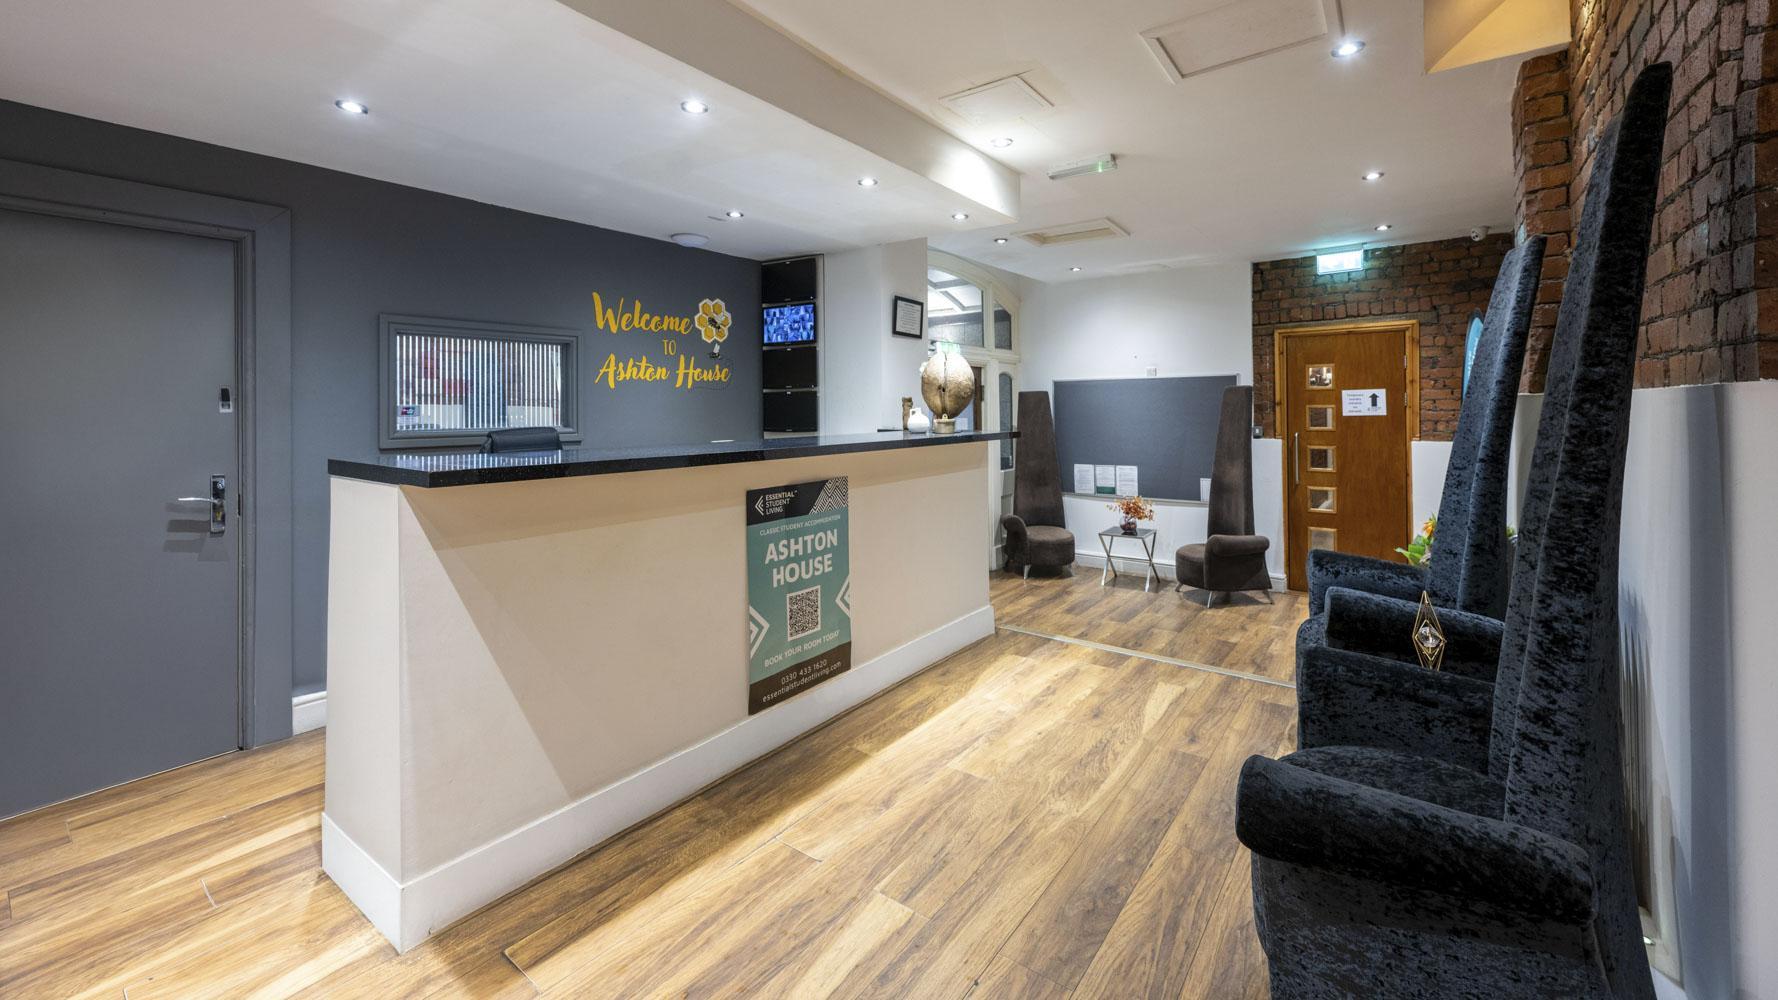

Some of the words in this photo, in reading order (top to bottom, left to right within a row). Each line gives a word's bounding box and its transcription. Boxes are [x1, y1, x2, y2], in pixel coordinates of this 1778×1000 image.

[592, 292, 692, 334] Welcome
[662, 339, 676, 355] TO
[595, 353, 669, 389] Ashton
[675, 354, 730, 389] House
[766, 492, 794, 501] ESSENTIAL
[766, 499, 790, 507] STUDENT
[760, 527, 780, 536] CLASSIC
[780, 523, 804, 531] STUDENT
[765, 529, 838, 564] ASHTON
[773, 554, 832, 588] HOUSE
[764, 653, 783, 667] BOOK
[785, 645, 802, 657] YOUR
[804, 638, 822, 650] ROOM
[823, 630, 840, 643] TODAY
[762, 662, 841, 702] essentialstudentliving.com
[781, 672, 797, 684] 0330
[800, 666, 812, 675] 433
[814, 660, 827, 670] 1620
